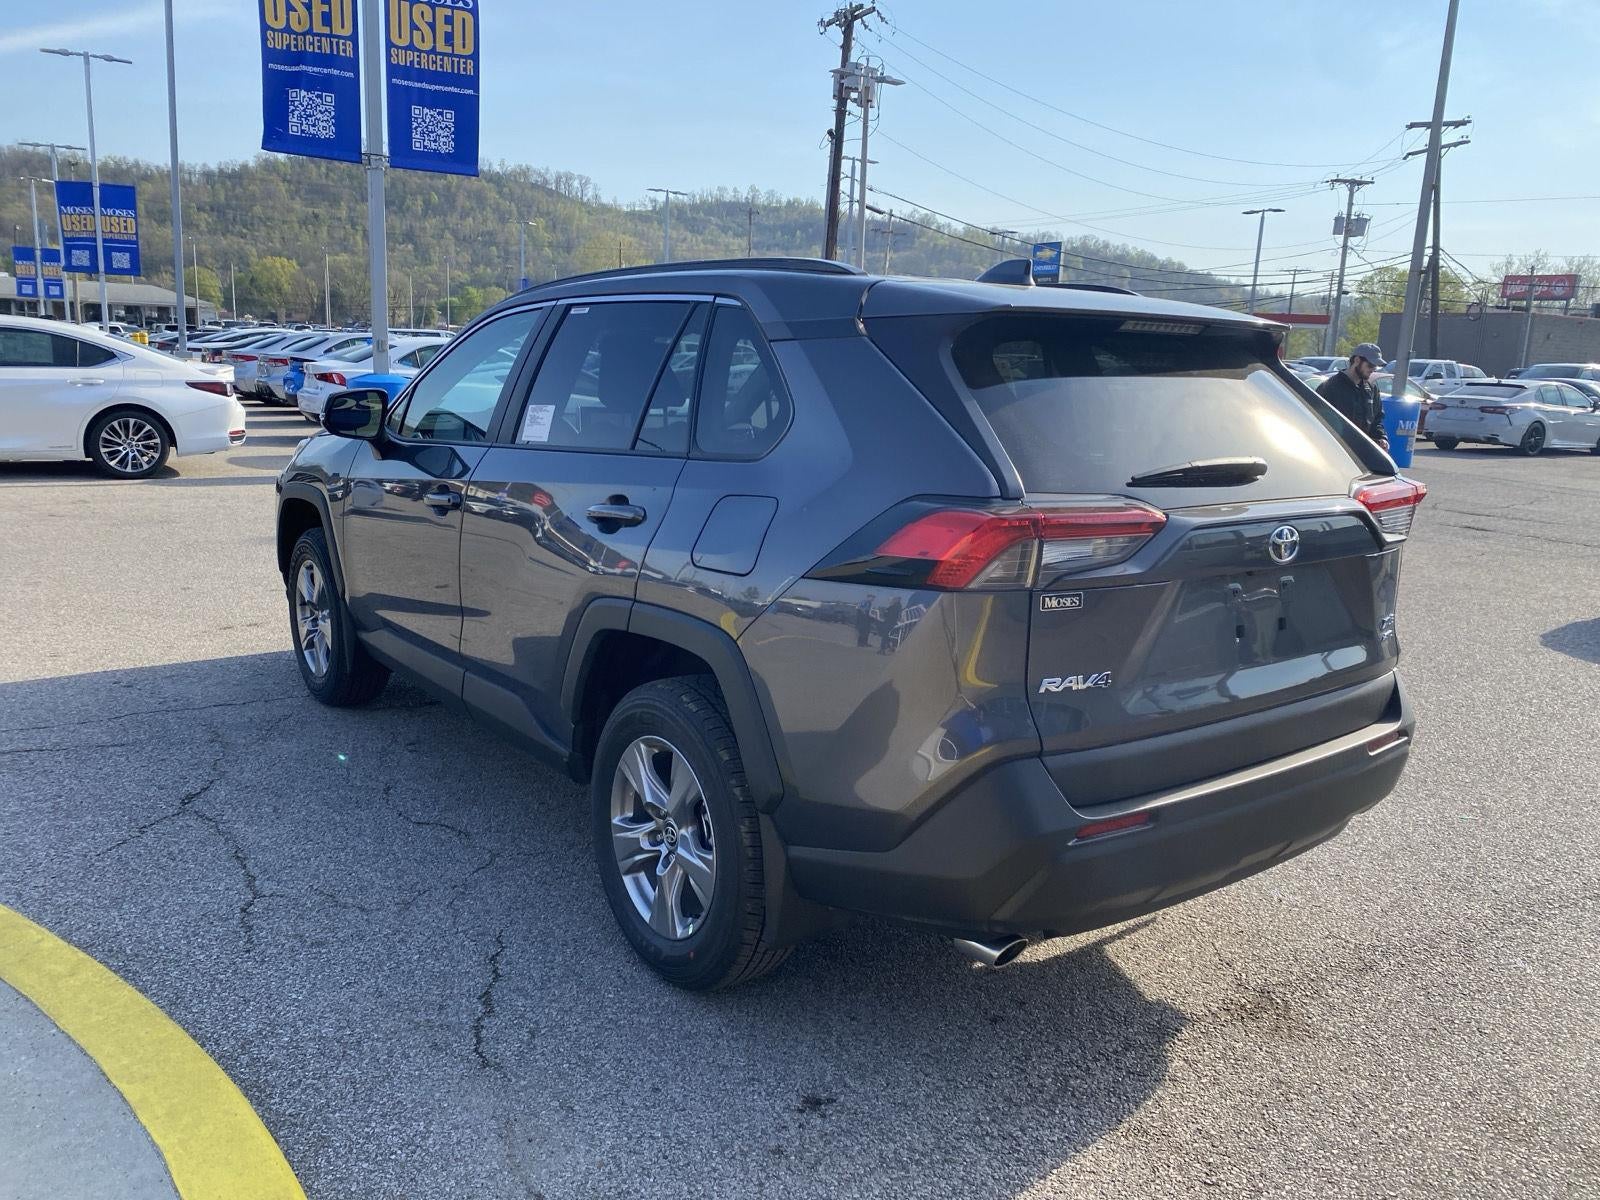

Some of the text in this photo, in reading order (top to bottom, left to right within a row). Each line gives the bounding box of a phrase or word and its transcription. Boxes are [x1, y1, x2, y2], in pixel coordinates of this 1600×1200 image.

[264, 0, 353, 36] USED
[389, 0, 475, 56] USED
[266, 30, 354, 58] SUPERCENTER
[390, 47, 474, 76] SUPERCENTER
[61, 214, 95, 231] USED
[100, 207, 135, 217] MOSES
[101, 215, 136, 234] USED
[1044, 596, 1080, 609] MOSES
[1038, 671, 1112, 693] RAV4
